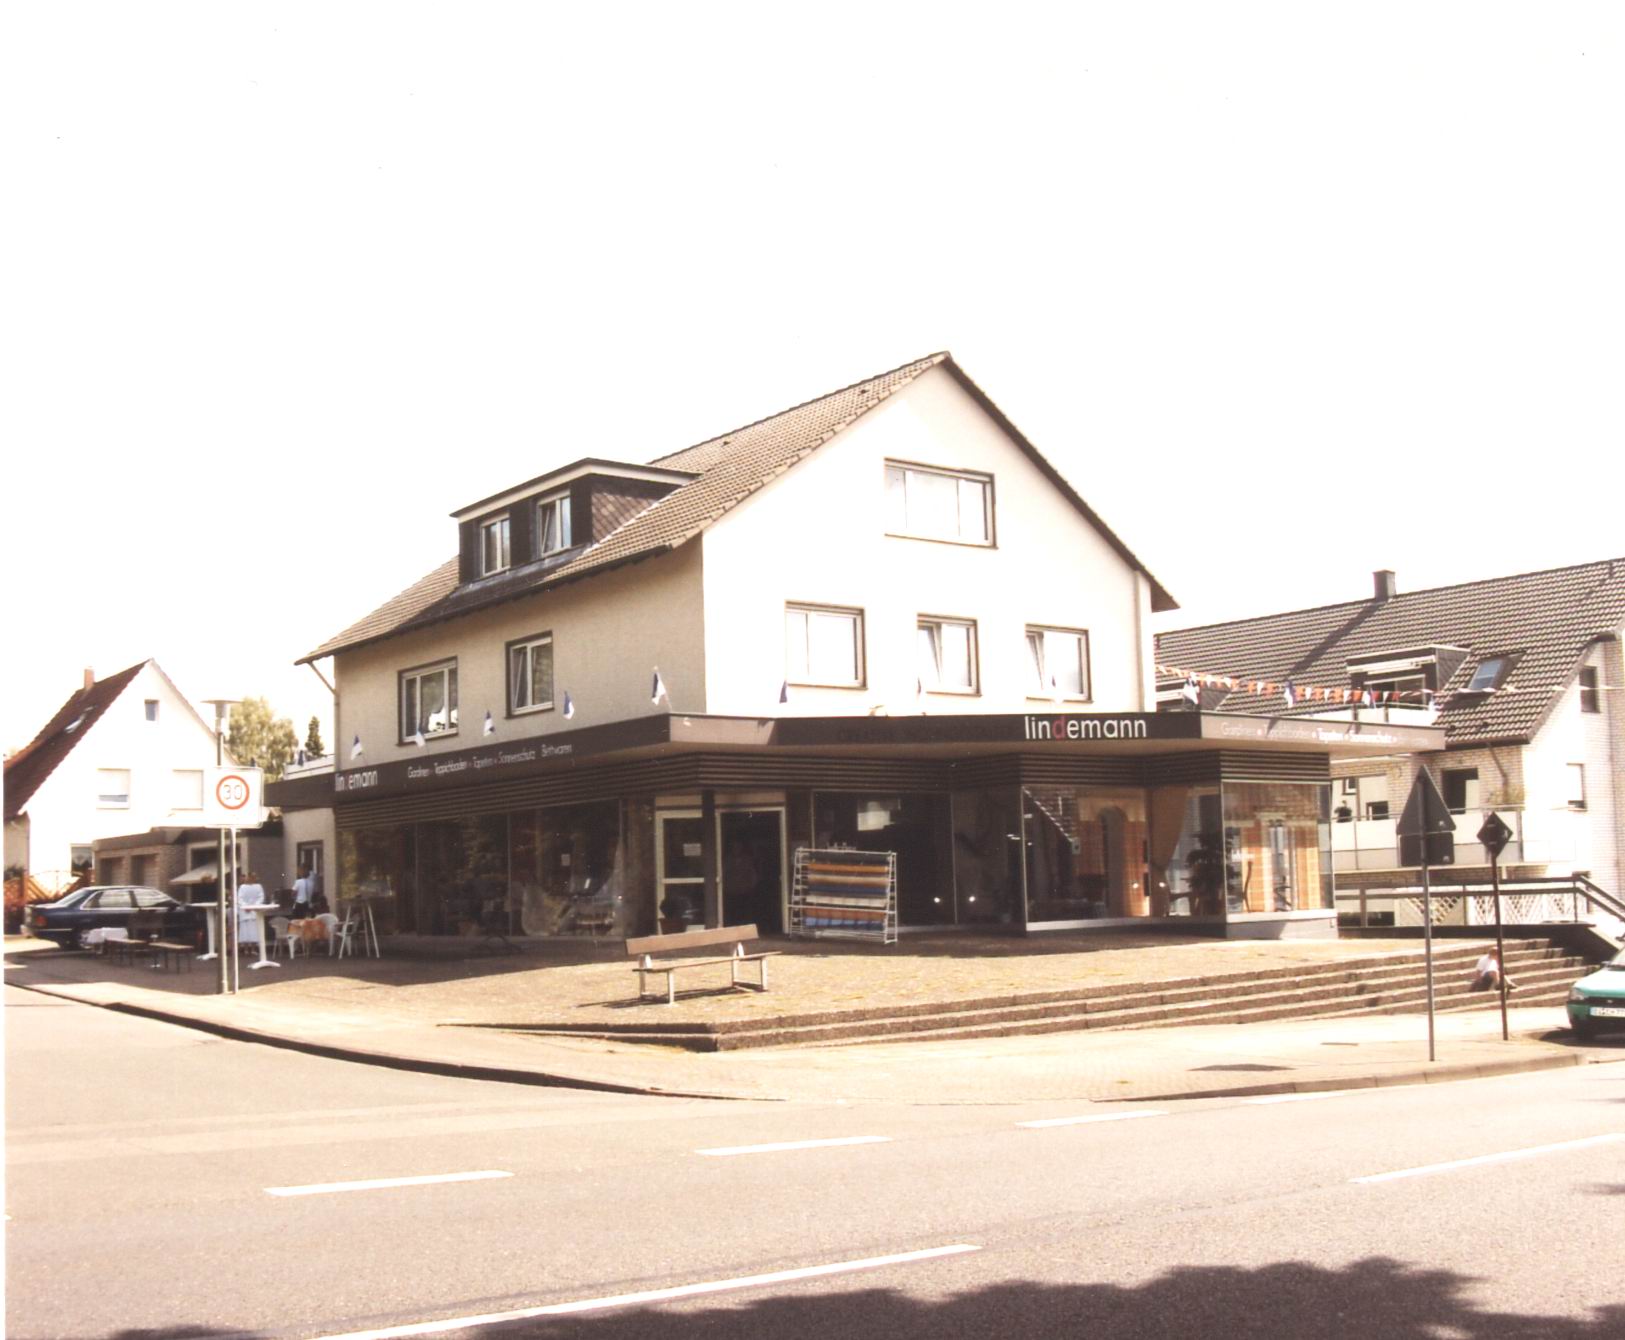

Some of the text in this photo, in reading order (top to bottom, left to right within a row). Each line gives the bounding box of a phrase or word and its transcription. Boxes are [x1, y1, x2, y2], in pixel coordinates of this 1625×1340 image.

[1024, 715, 1147, 740] lindemann
[335, 770, 378, 792] linemann
[223, 784, 243, 801] 30
